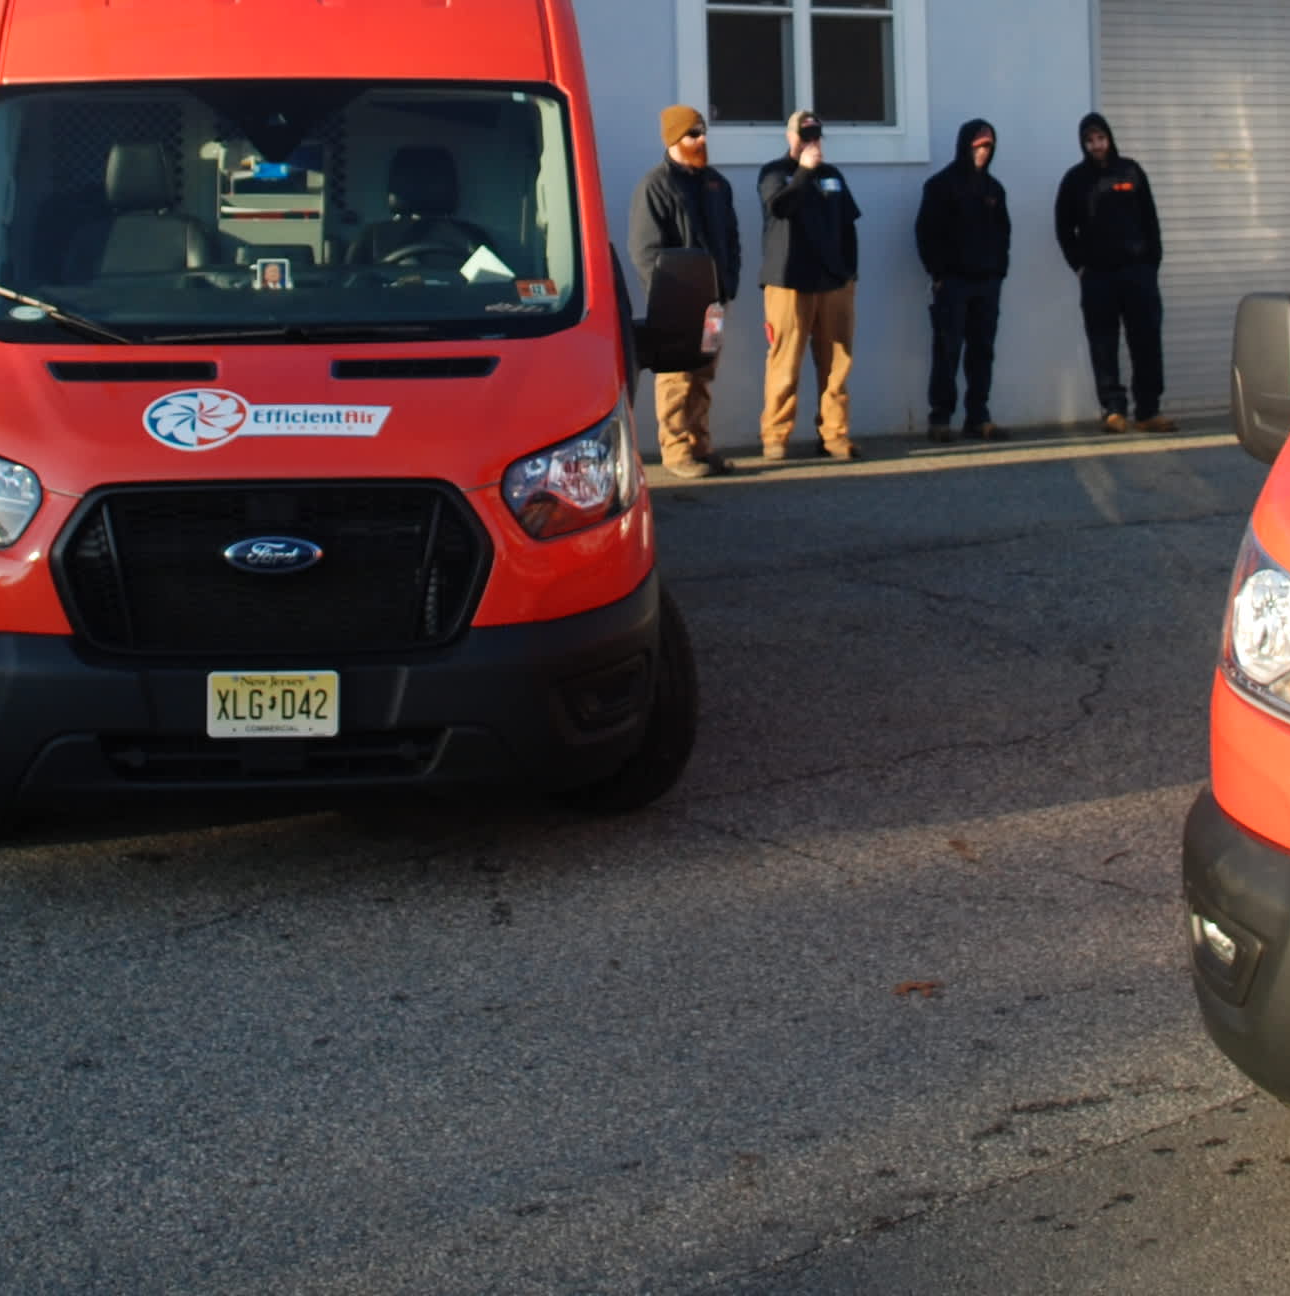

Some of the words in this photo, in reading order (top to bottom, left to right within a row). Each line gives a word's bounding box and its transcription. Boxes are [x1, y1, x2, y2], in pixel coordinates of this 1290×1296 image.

[246, 542, 300, 564] Ford
[217, 688, 263, 720] XLG
[281, 688, 328, 720] D42
